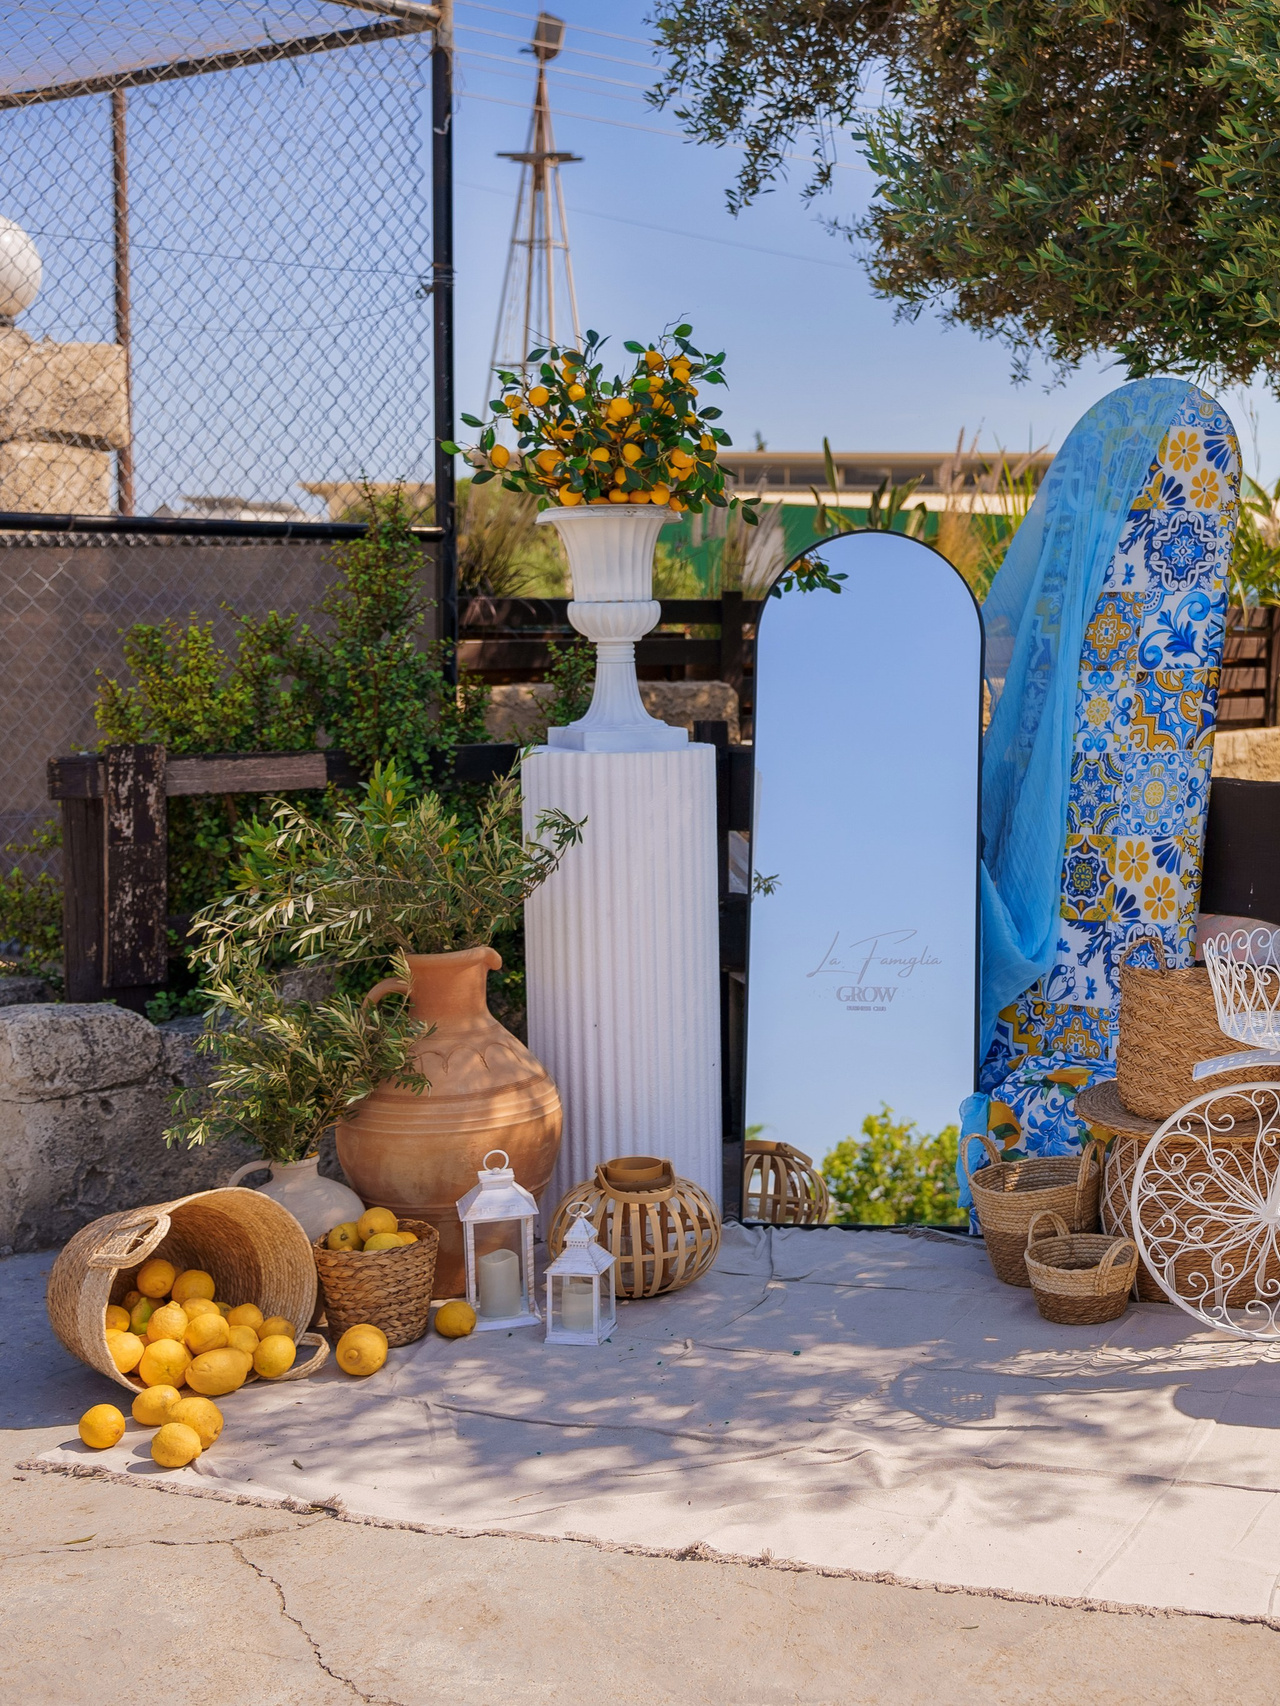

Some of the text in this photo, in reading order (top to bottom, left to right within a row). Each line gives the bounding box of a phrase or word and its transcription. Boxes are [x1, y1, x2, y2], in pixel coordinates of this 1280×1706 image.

[806, 929, 943, 985] La Famiglia
[836, 986, 899, 1003] GROW
